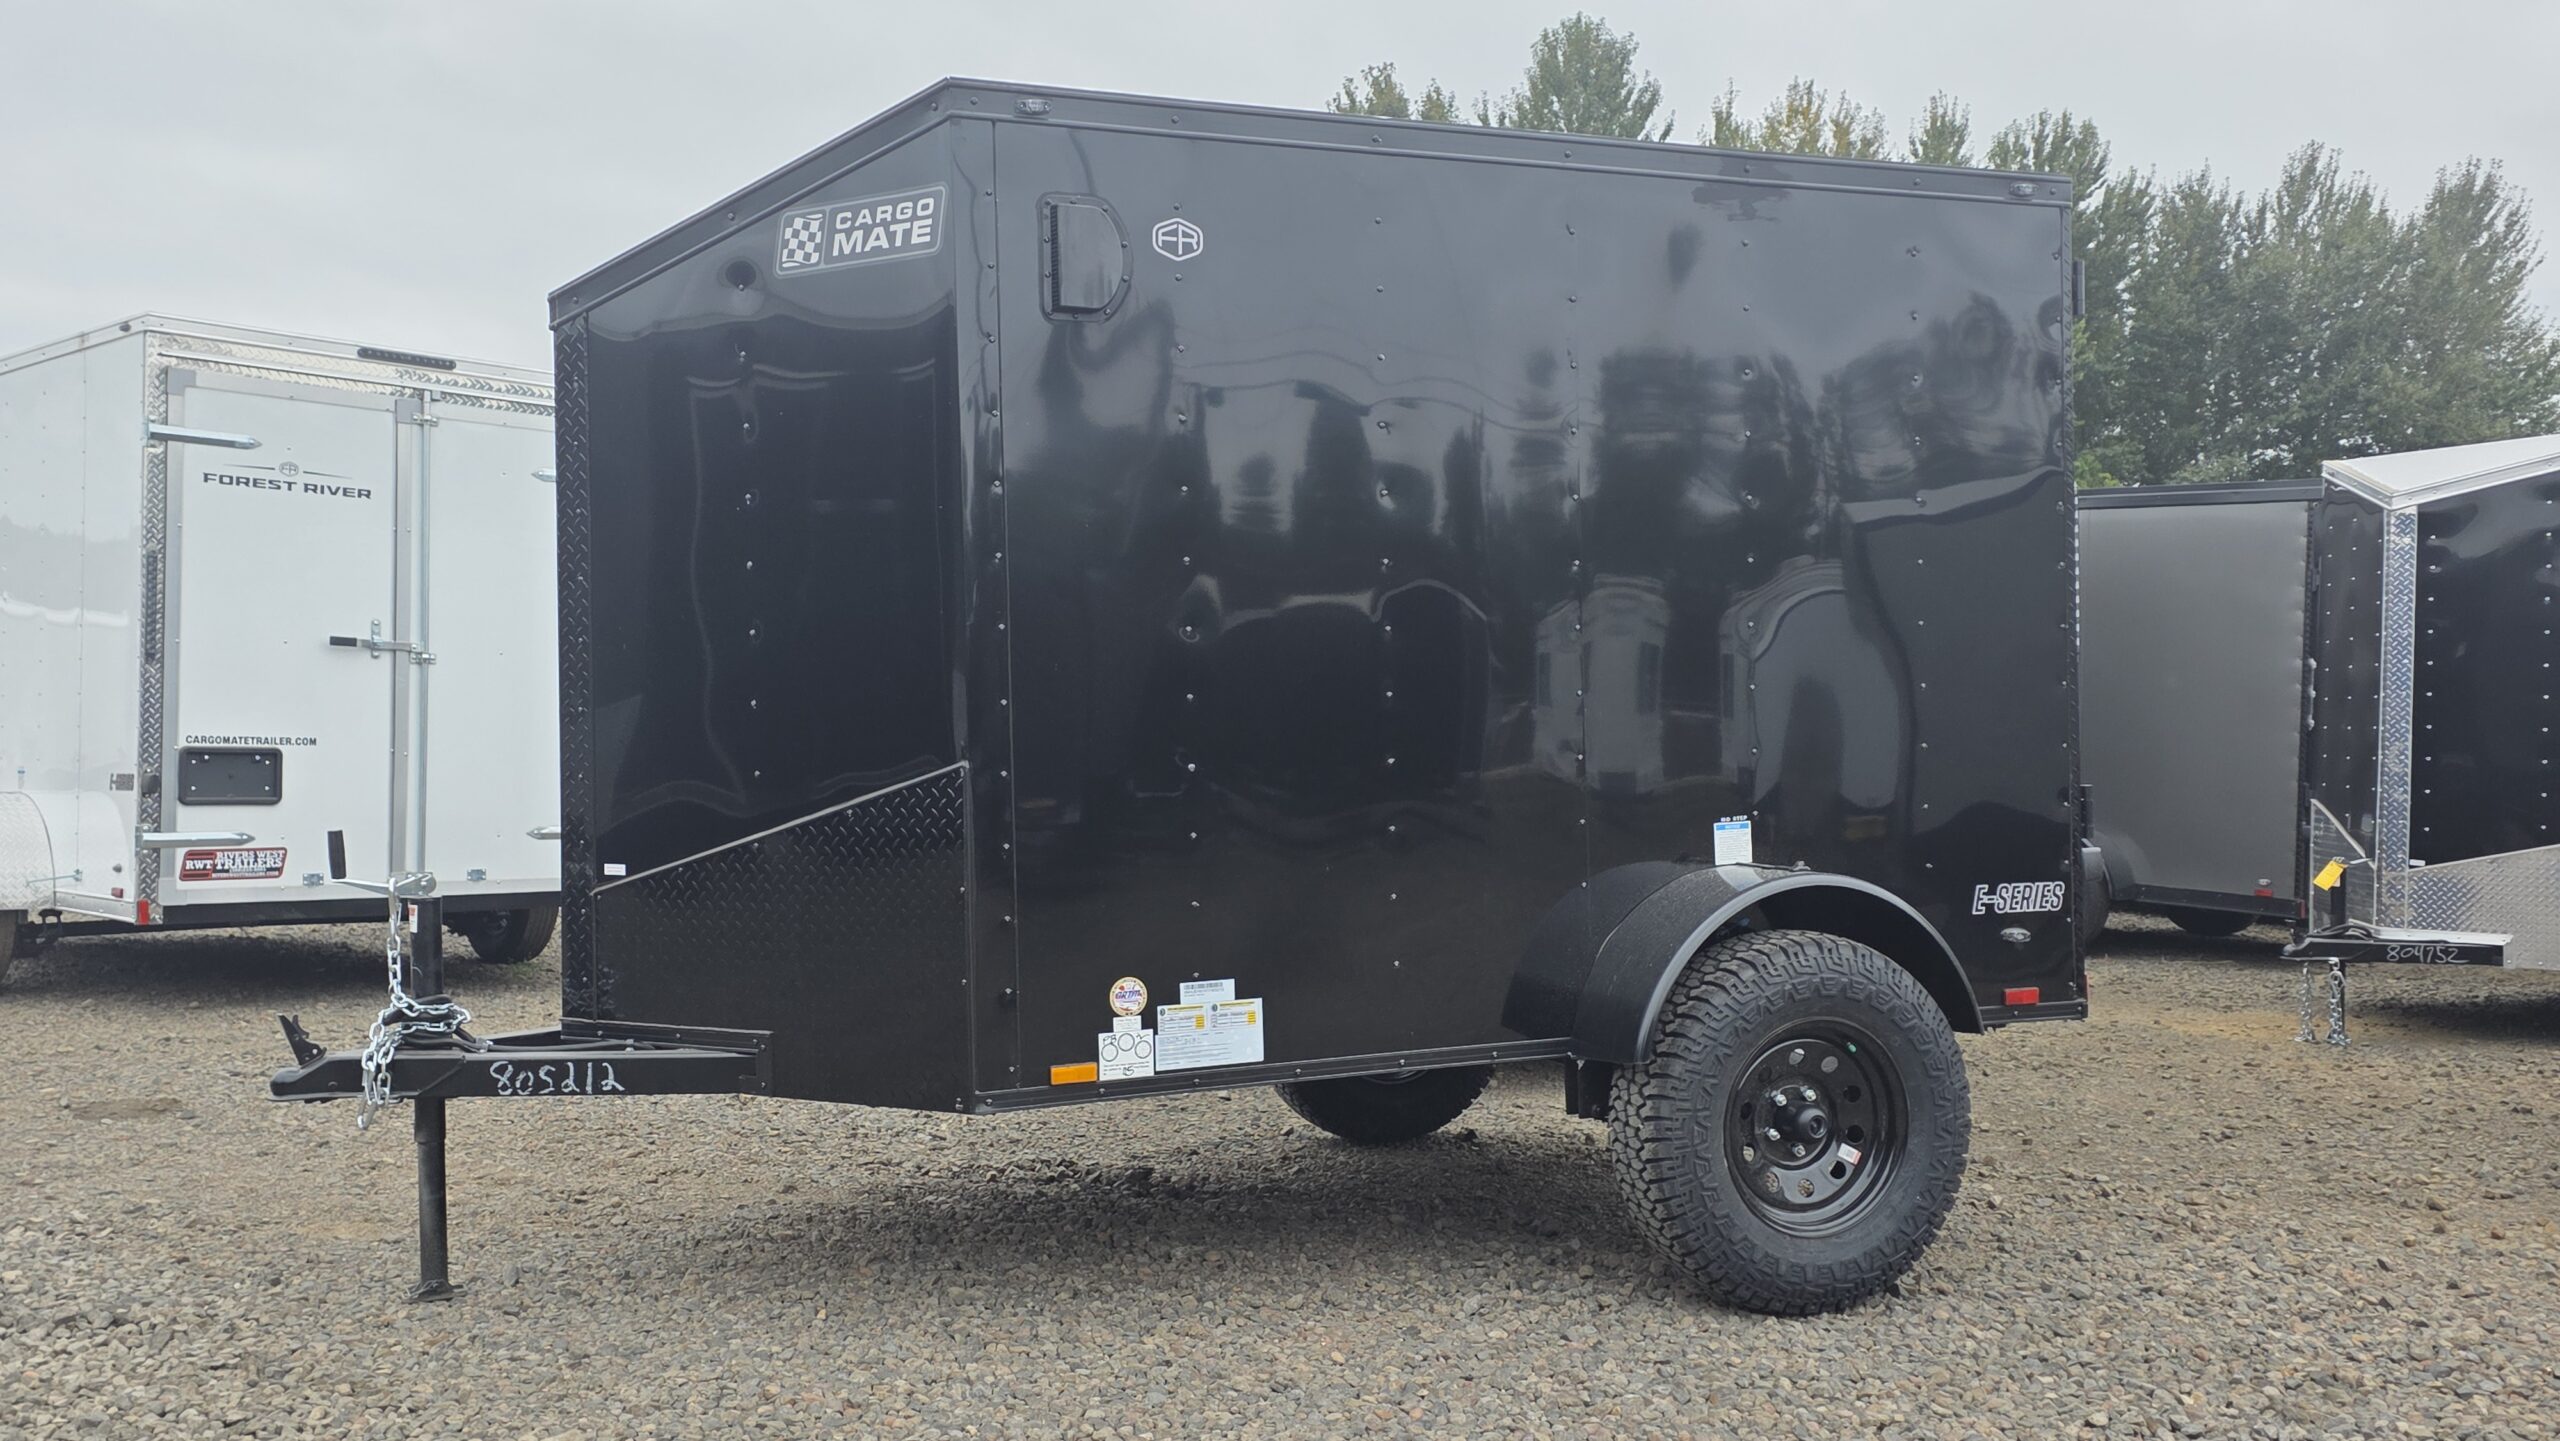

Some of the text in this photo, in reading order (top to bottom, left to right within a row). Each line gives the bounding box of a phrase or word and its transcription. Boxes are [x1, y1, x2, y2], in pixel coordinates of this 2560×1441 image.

[835, 197, 935, 230] CARGO
[832, 218, 933, 256] MATE
[203, 472, 372, 500] FOREST RIVER
[185, 735, 317, 746] CARGOMATETRAILER.COM
[185, 860, 213, 870] RWT
[214, 858, 283, 870] TRAILERS
[216, 849, 285, 861] RIVERS WEST
[1972, 881, 2065, 915] E-SERIES
[2386, 944, 2471, 963] 804752
[490, 1061, 625, 1095] 805212
